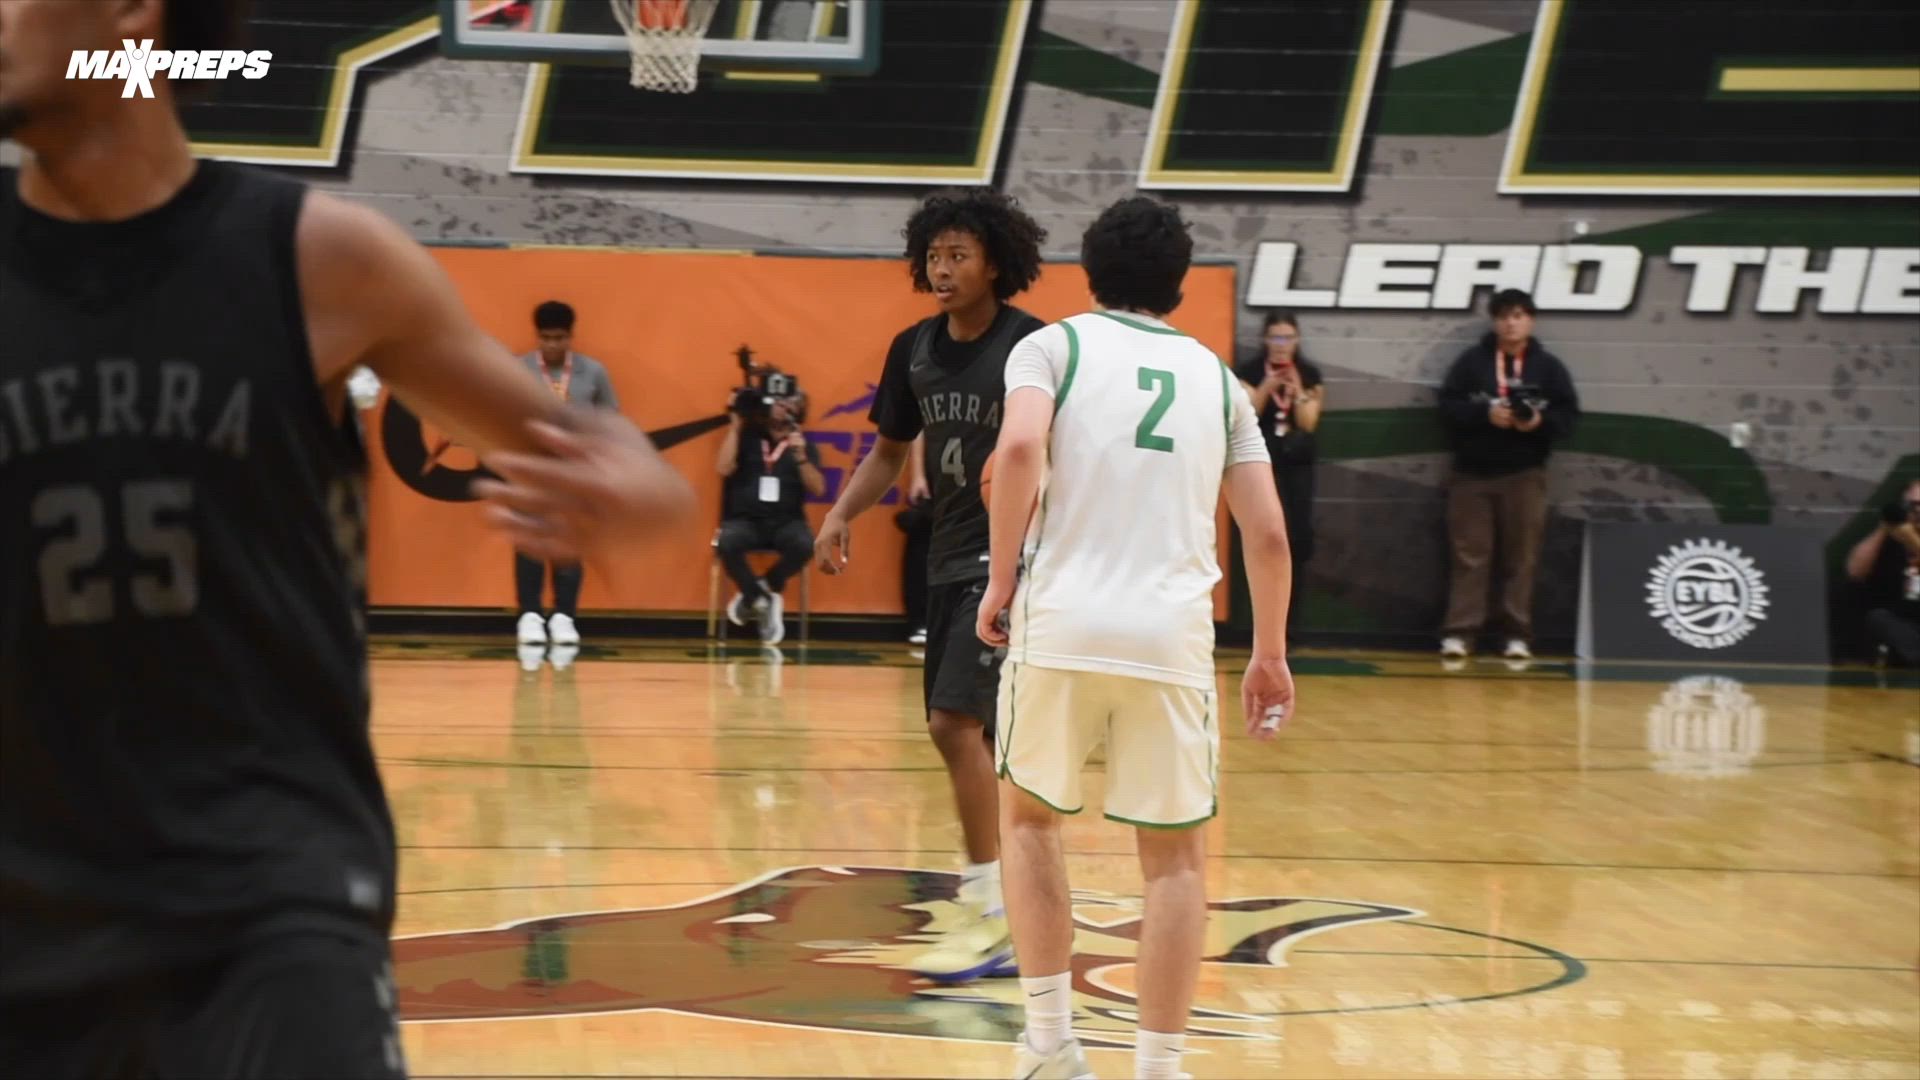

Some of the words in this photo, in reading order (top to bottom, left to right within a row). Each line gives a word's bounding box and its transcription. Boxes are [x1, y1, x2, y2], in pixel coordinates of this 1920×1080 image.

[1246, 242, 1642, 310] LEAD
[1669, 246, 1920, 313] THE
[1135, 366, 1175, 453] 2
[941, 437, 967, 487] 4
[30, 480, 201, 626] 25
[1676, 580, 1738, 603] EYBL
